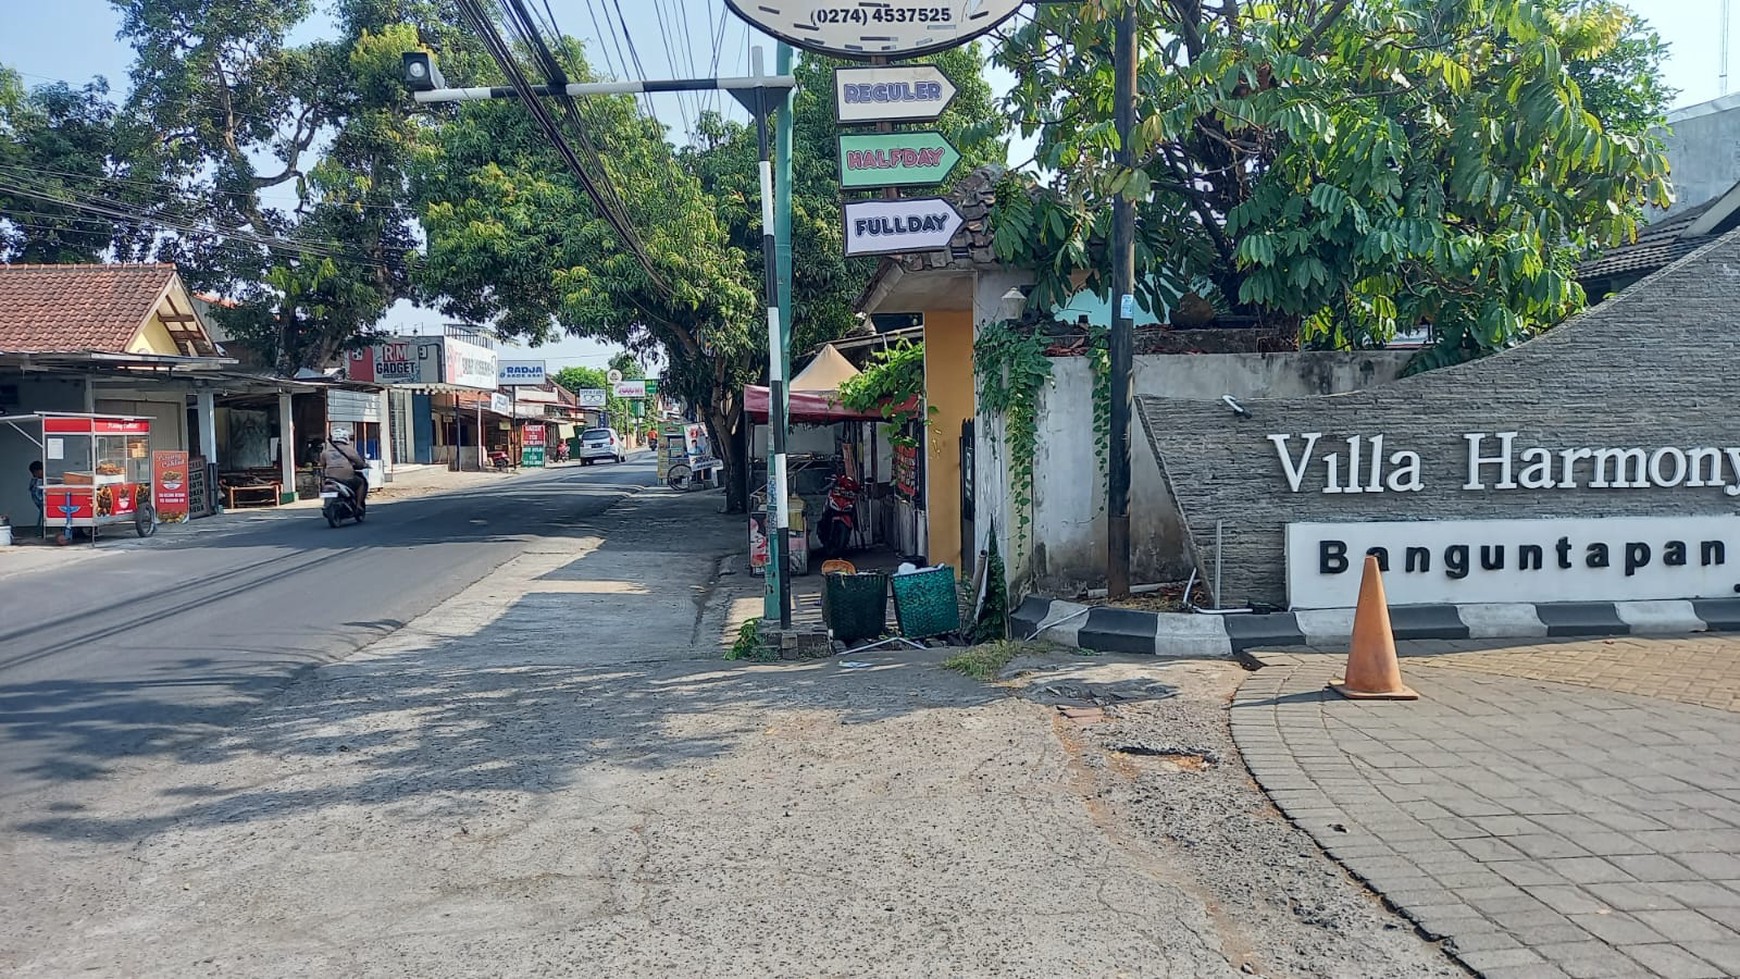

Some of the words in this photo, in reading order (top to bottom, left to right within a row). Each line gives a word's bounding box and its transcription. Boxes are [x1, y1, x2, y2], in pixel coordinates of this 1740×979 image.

[810, 8, 867, 26] (0274)
[872, 8, 952, 22] 4537525
[843, 81, 942, 104] REGULER
[847, 147, 945, 171] HALFDAY
[855, 212, 950, 237] FULLDAY
[383, 343, 408, 362] RM
[376, 362, 415, 374] GADGET
[506, 366, 543, 374] RADJA
[1267, 432, 1425, 494] Villa
[1463, 431, 1740, 496] Harmony
